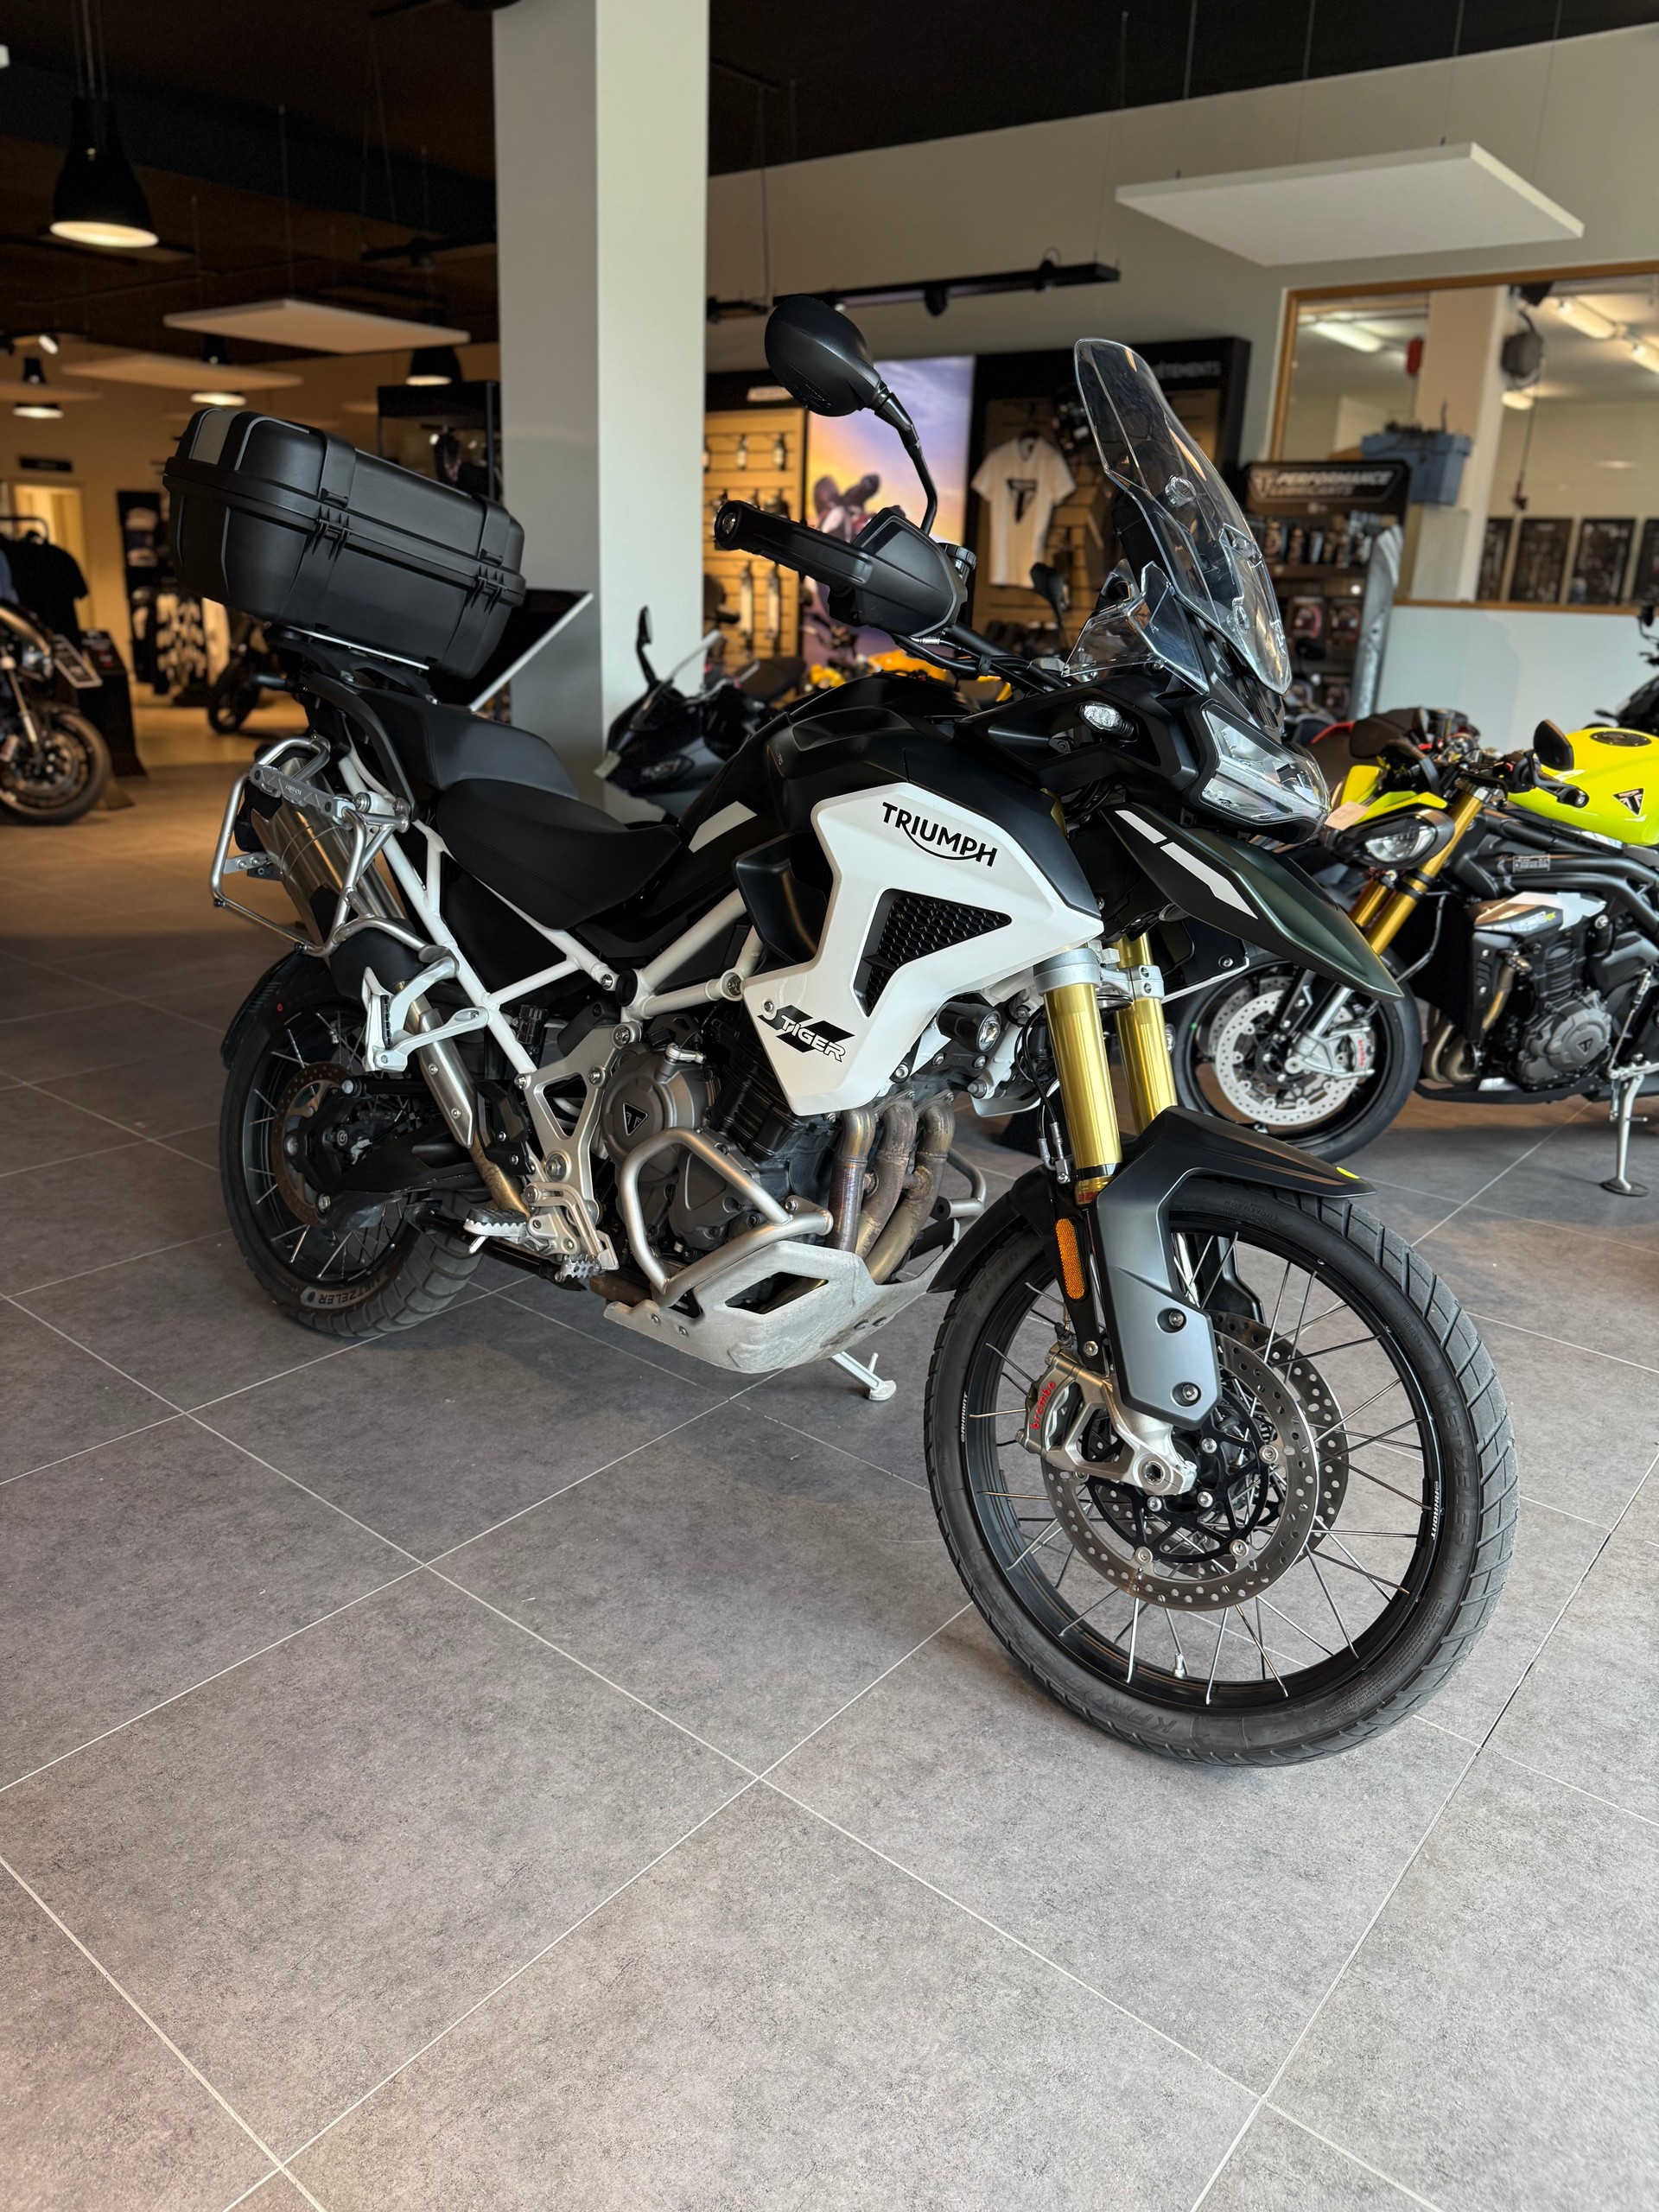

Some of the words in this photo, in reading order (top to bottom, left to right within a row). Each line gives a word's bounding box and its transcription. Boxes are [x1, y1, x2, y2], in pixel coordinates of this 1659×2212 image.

[1275, 471, 1394, 486] PERFORMANCE
[882, 802, 998, 868] TRIUMPH
[780, 1014, 846, 1063] TIGER
[318, 1276, 381, 1305] METZELER
[1029, 1381, 1056, 1430] brembo
[1433, 1384, 1469, 1545] METZELER
